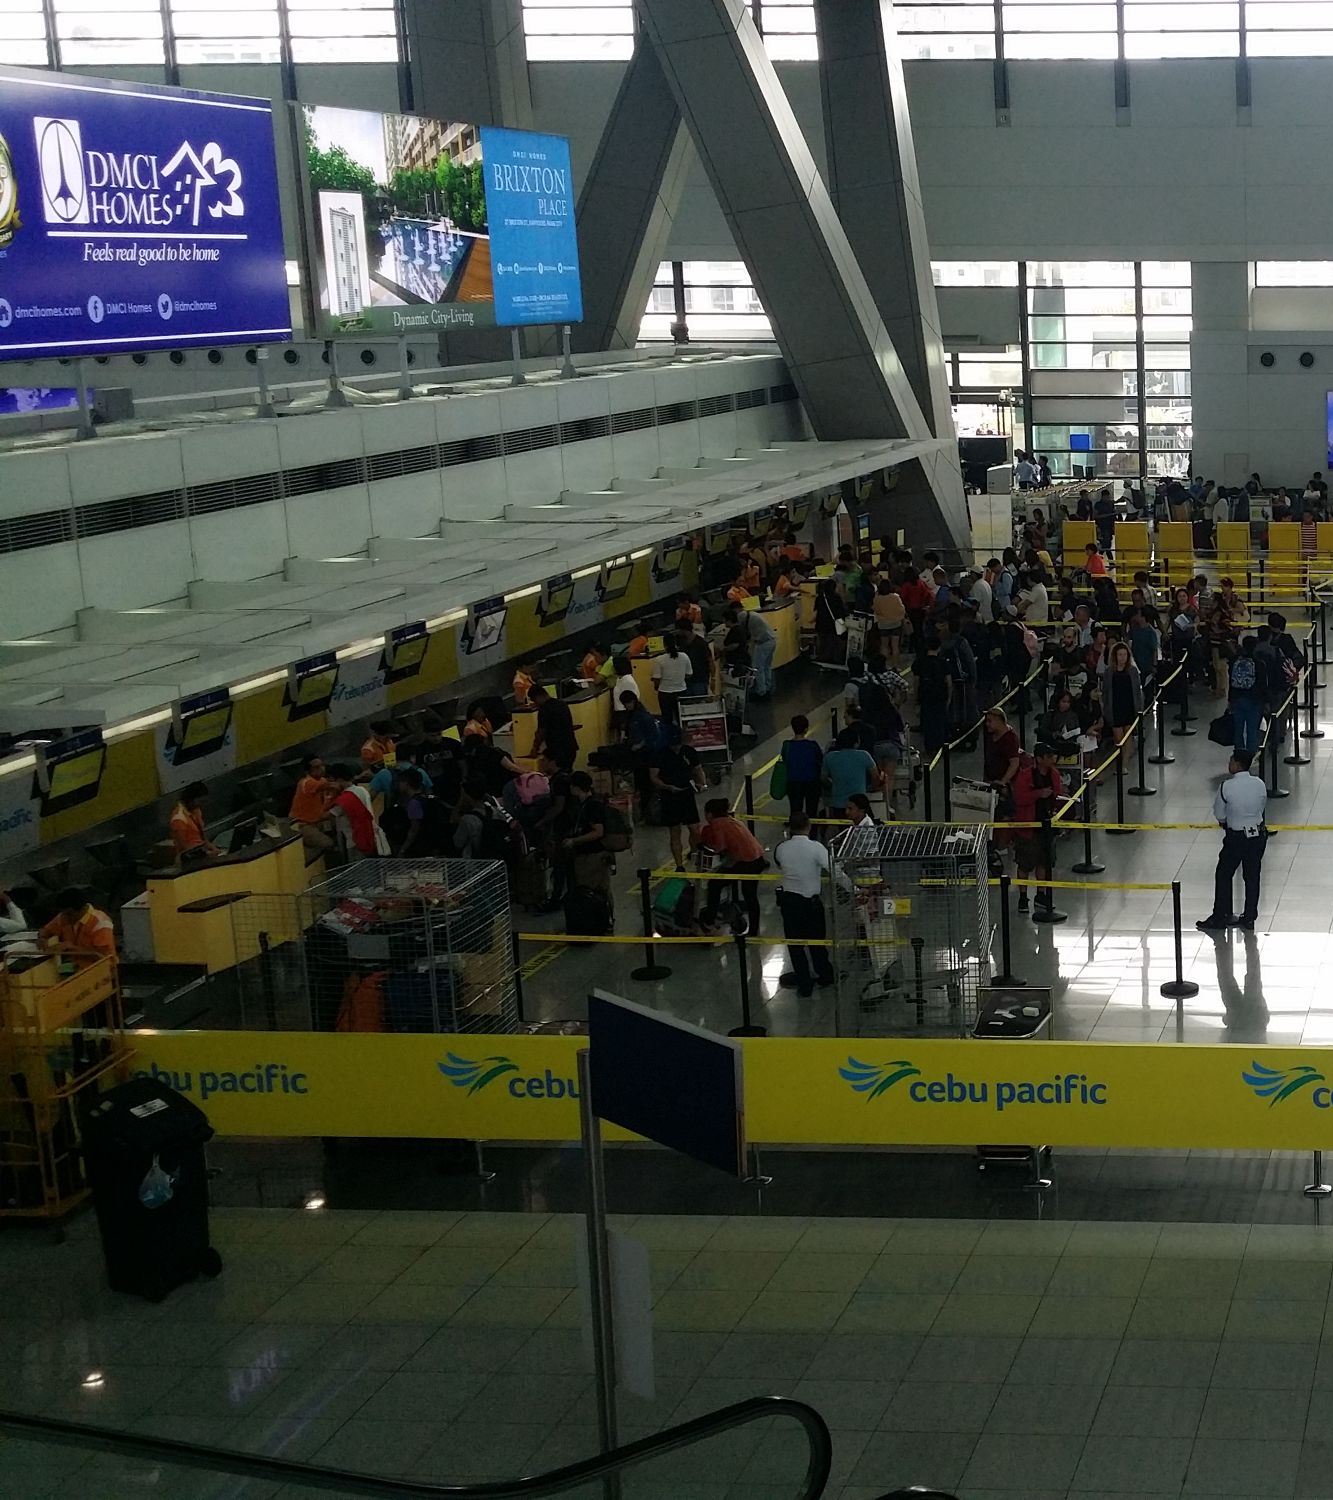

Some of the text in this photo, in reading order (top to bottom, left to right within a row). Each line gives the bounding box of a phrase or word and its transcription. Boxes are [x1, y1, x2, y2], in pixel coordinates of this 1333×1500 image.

[85, 150, 161, 190] DMCI
[492, 163, 566, 195] BRIXTON
[91, 191, 174, 225] HOMES
[537, 198, 568, 216] PLACE
[83, 242, 220, 267] Feels real good to be home
[14, 305, 83, 319] dmcihomes.com
[106, 302, 153, 315] DMCI Homes
[174, 300, 218, 313] @dmcihomes
[392, 307, 475, 331] Dynamic City-Living
[199, 1063, 309, 1100] pacific
[507, 1069, 582, 1099] cebu
[909, 1072, 1108, 1112] cebu pacific
